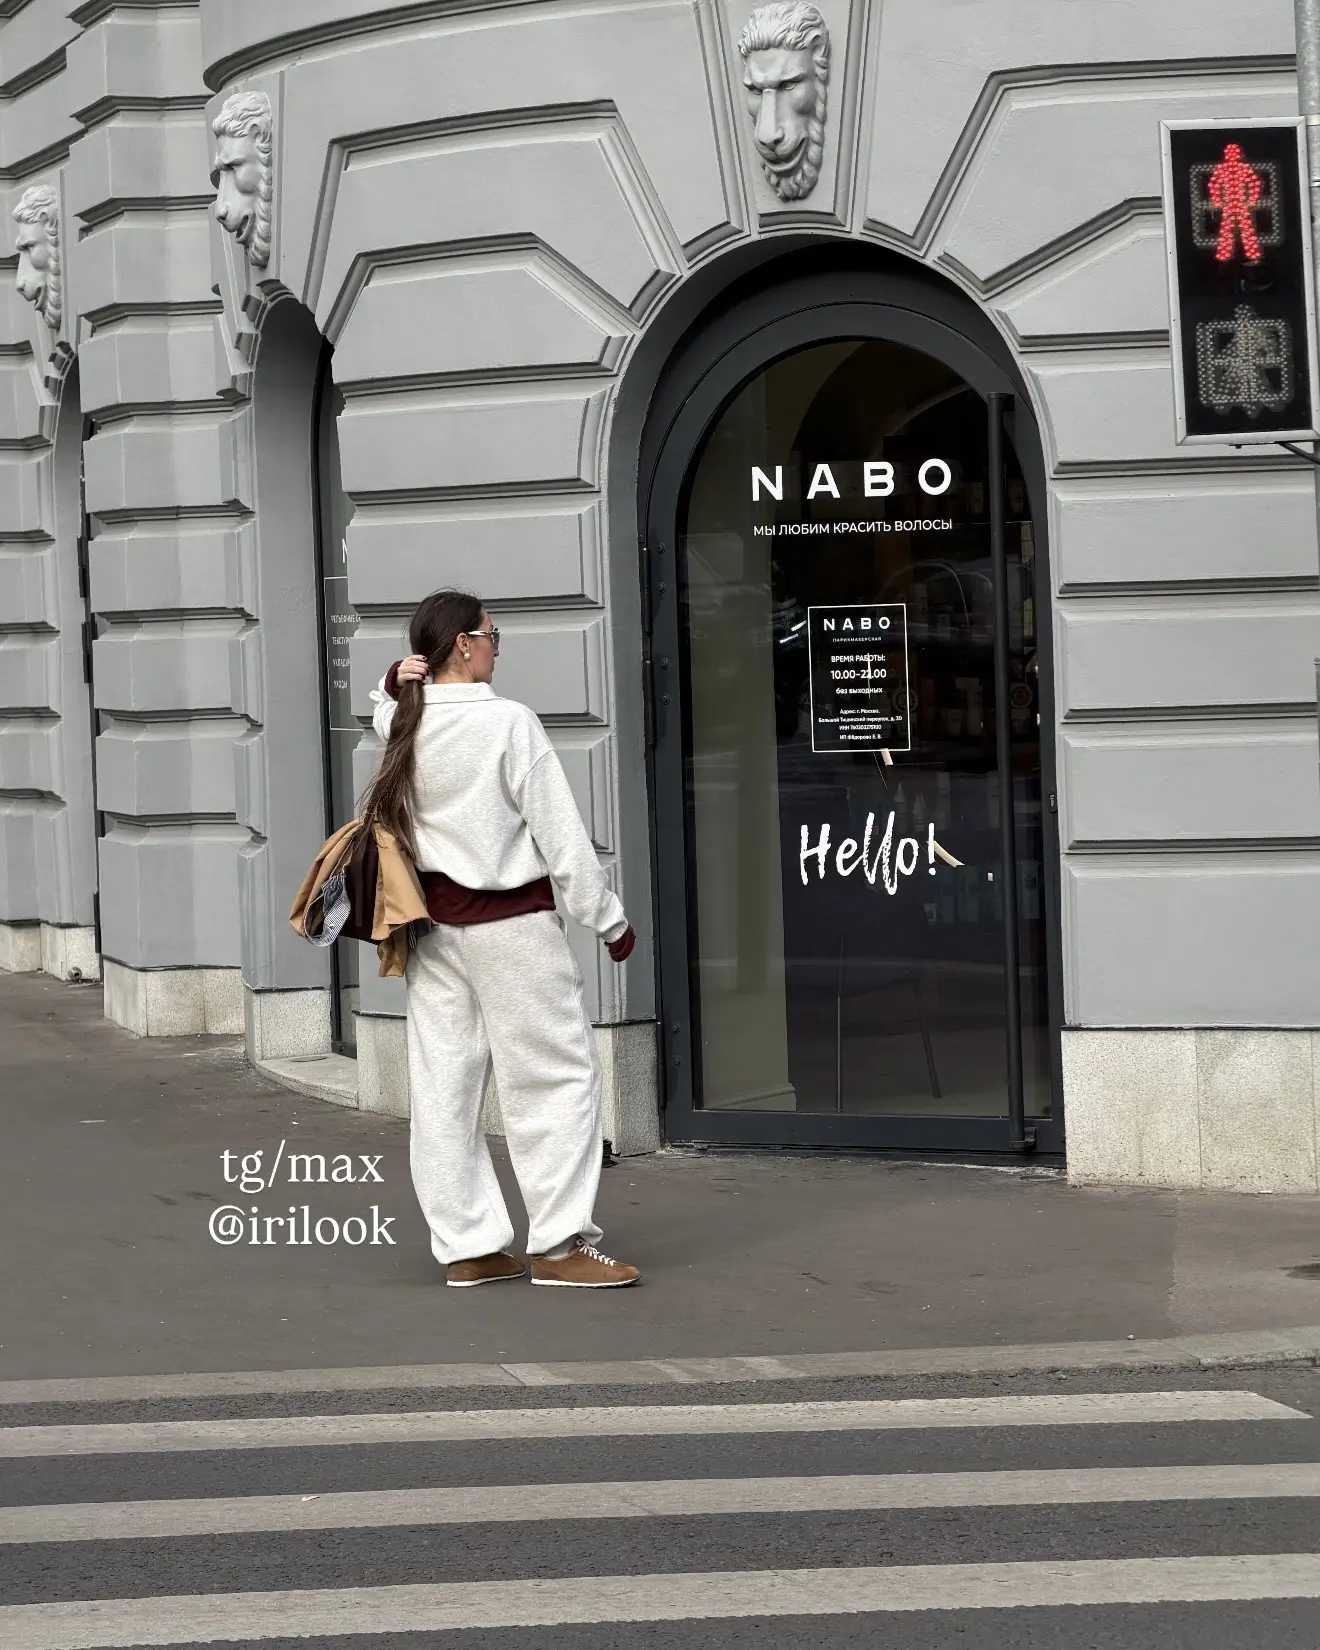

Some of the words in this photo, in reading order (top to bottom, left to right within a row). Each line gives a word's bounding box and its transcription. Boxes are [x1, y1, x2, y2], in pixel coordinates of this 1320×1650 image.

[752, 458, 951, 501] NABO
[753, 525, 776, 536] МЫ
[778, 523, 830, 535] ЛЮБИМ
[833, 521, 891, 533] КРАСИТЬ
[895, 518, 953, 531] ВОЛОСЫ
[823, 616, 891, 631] NABO
[831, 655, 854, 663] ВРЕМЯ
[855, 654, 886, 662] РАБОТЫ:
[800, 810, 936, 895] Hello!
